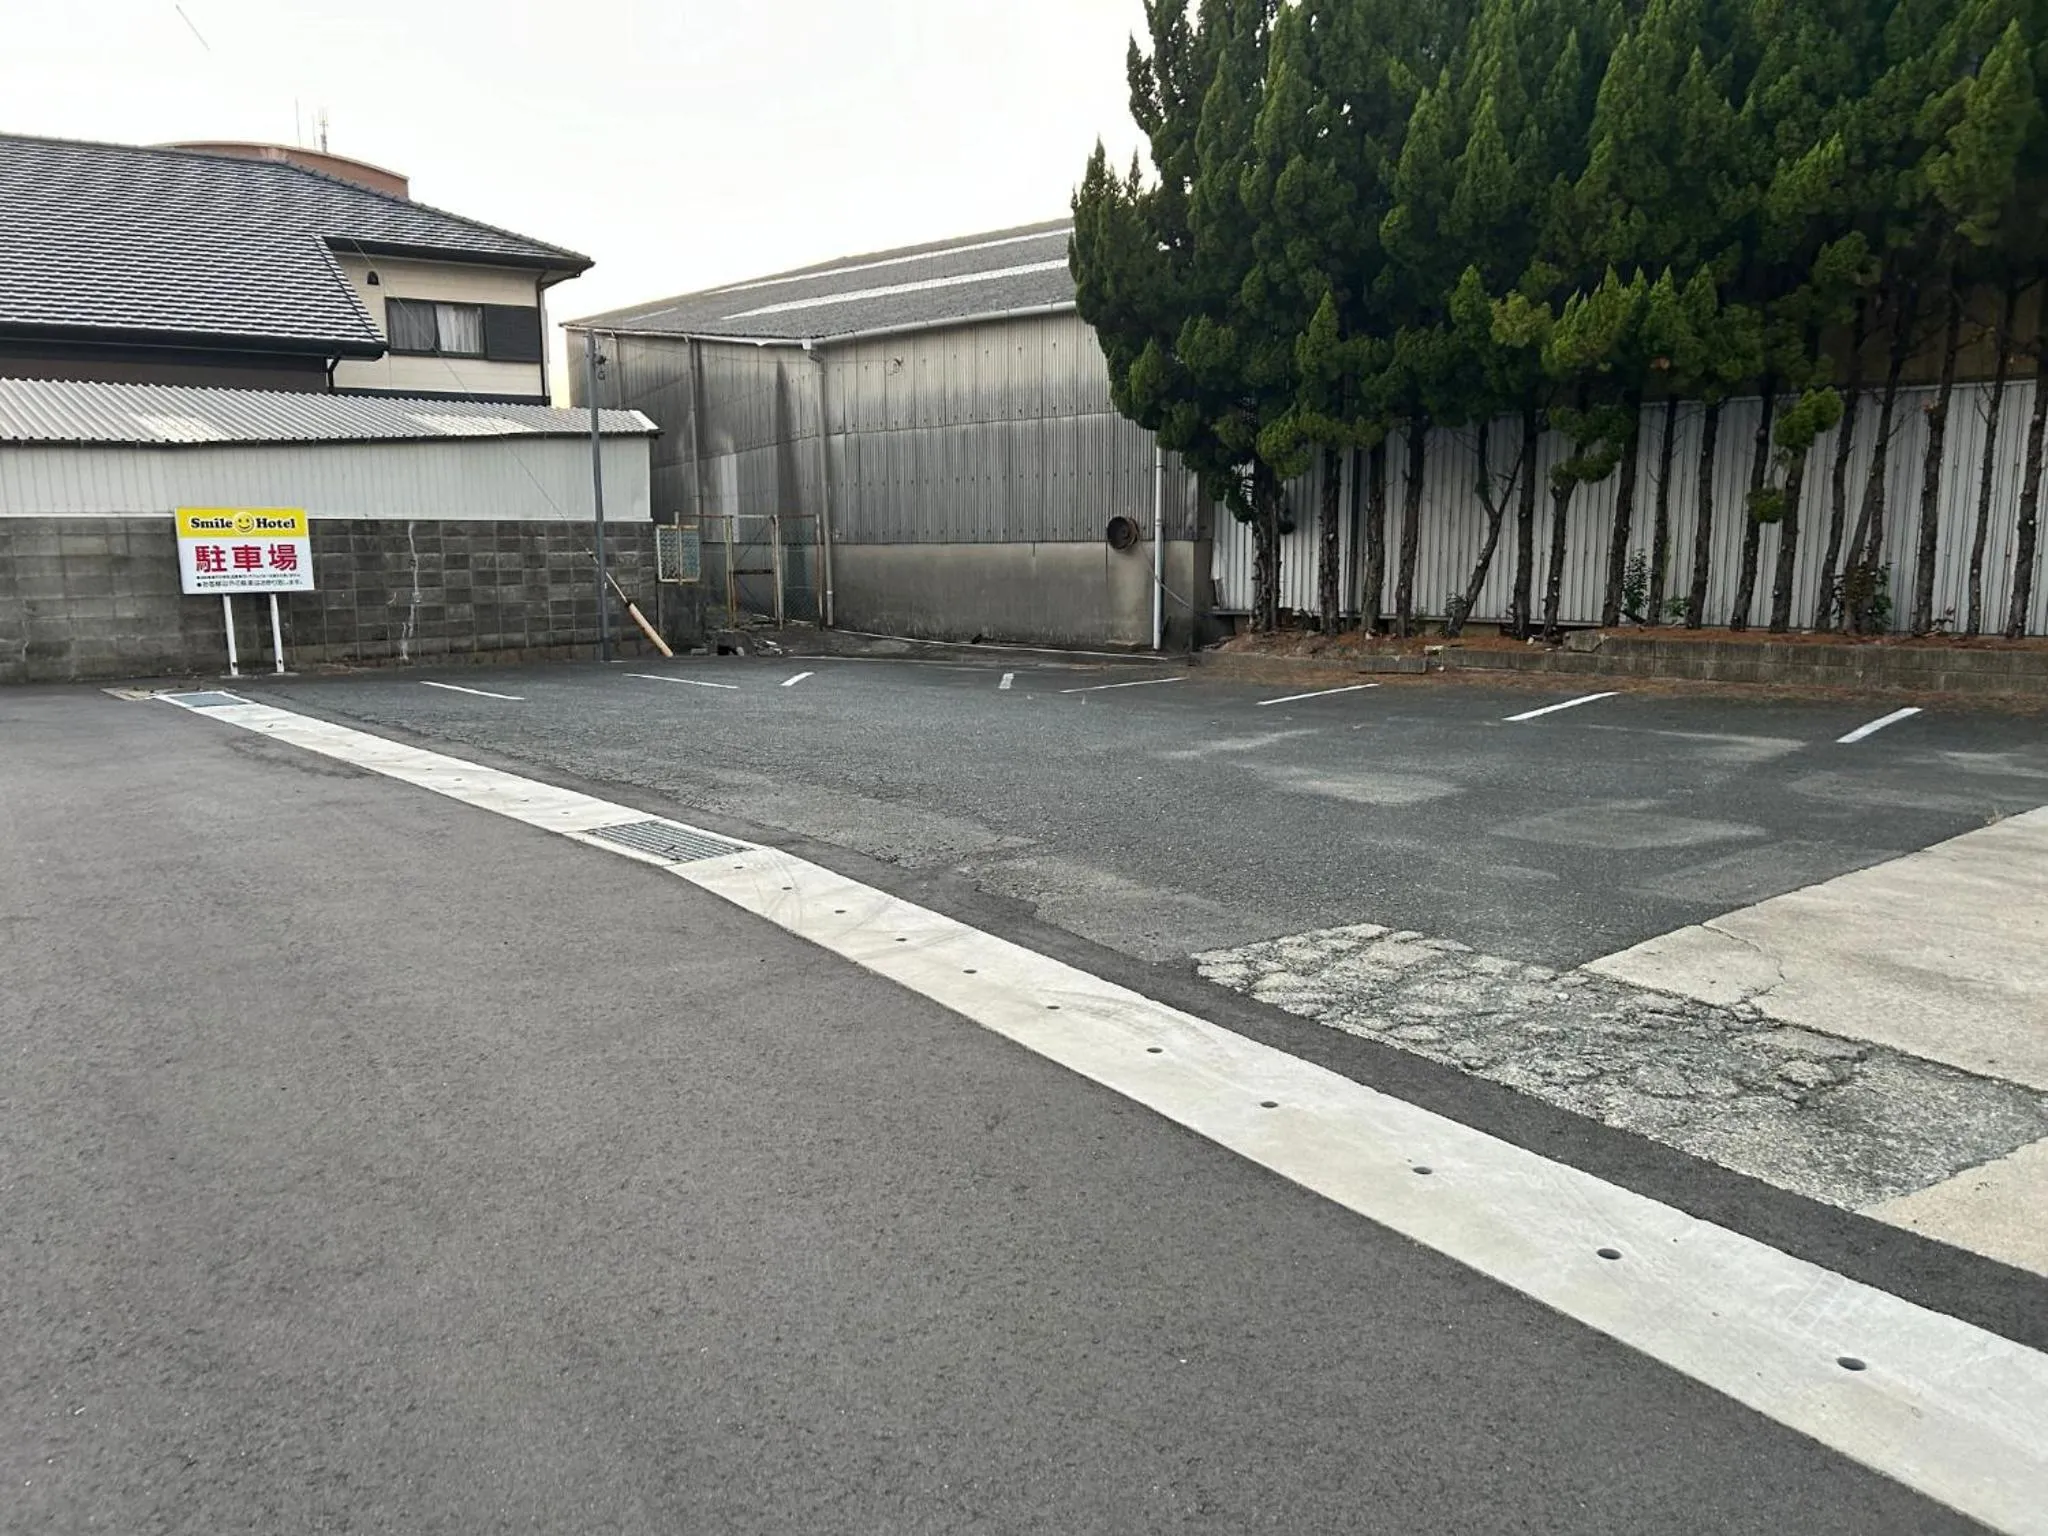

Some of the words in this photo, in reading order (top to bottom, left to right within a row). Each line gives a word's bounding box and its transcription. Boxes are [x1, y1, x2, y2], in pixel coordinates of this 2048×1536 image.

[190, 518, 233, 529] Smile
[256, 518, 296, 529] Hotel
[195, 543, 298, 573] 駐車場
